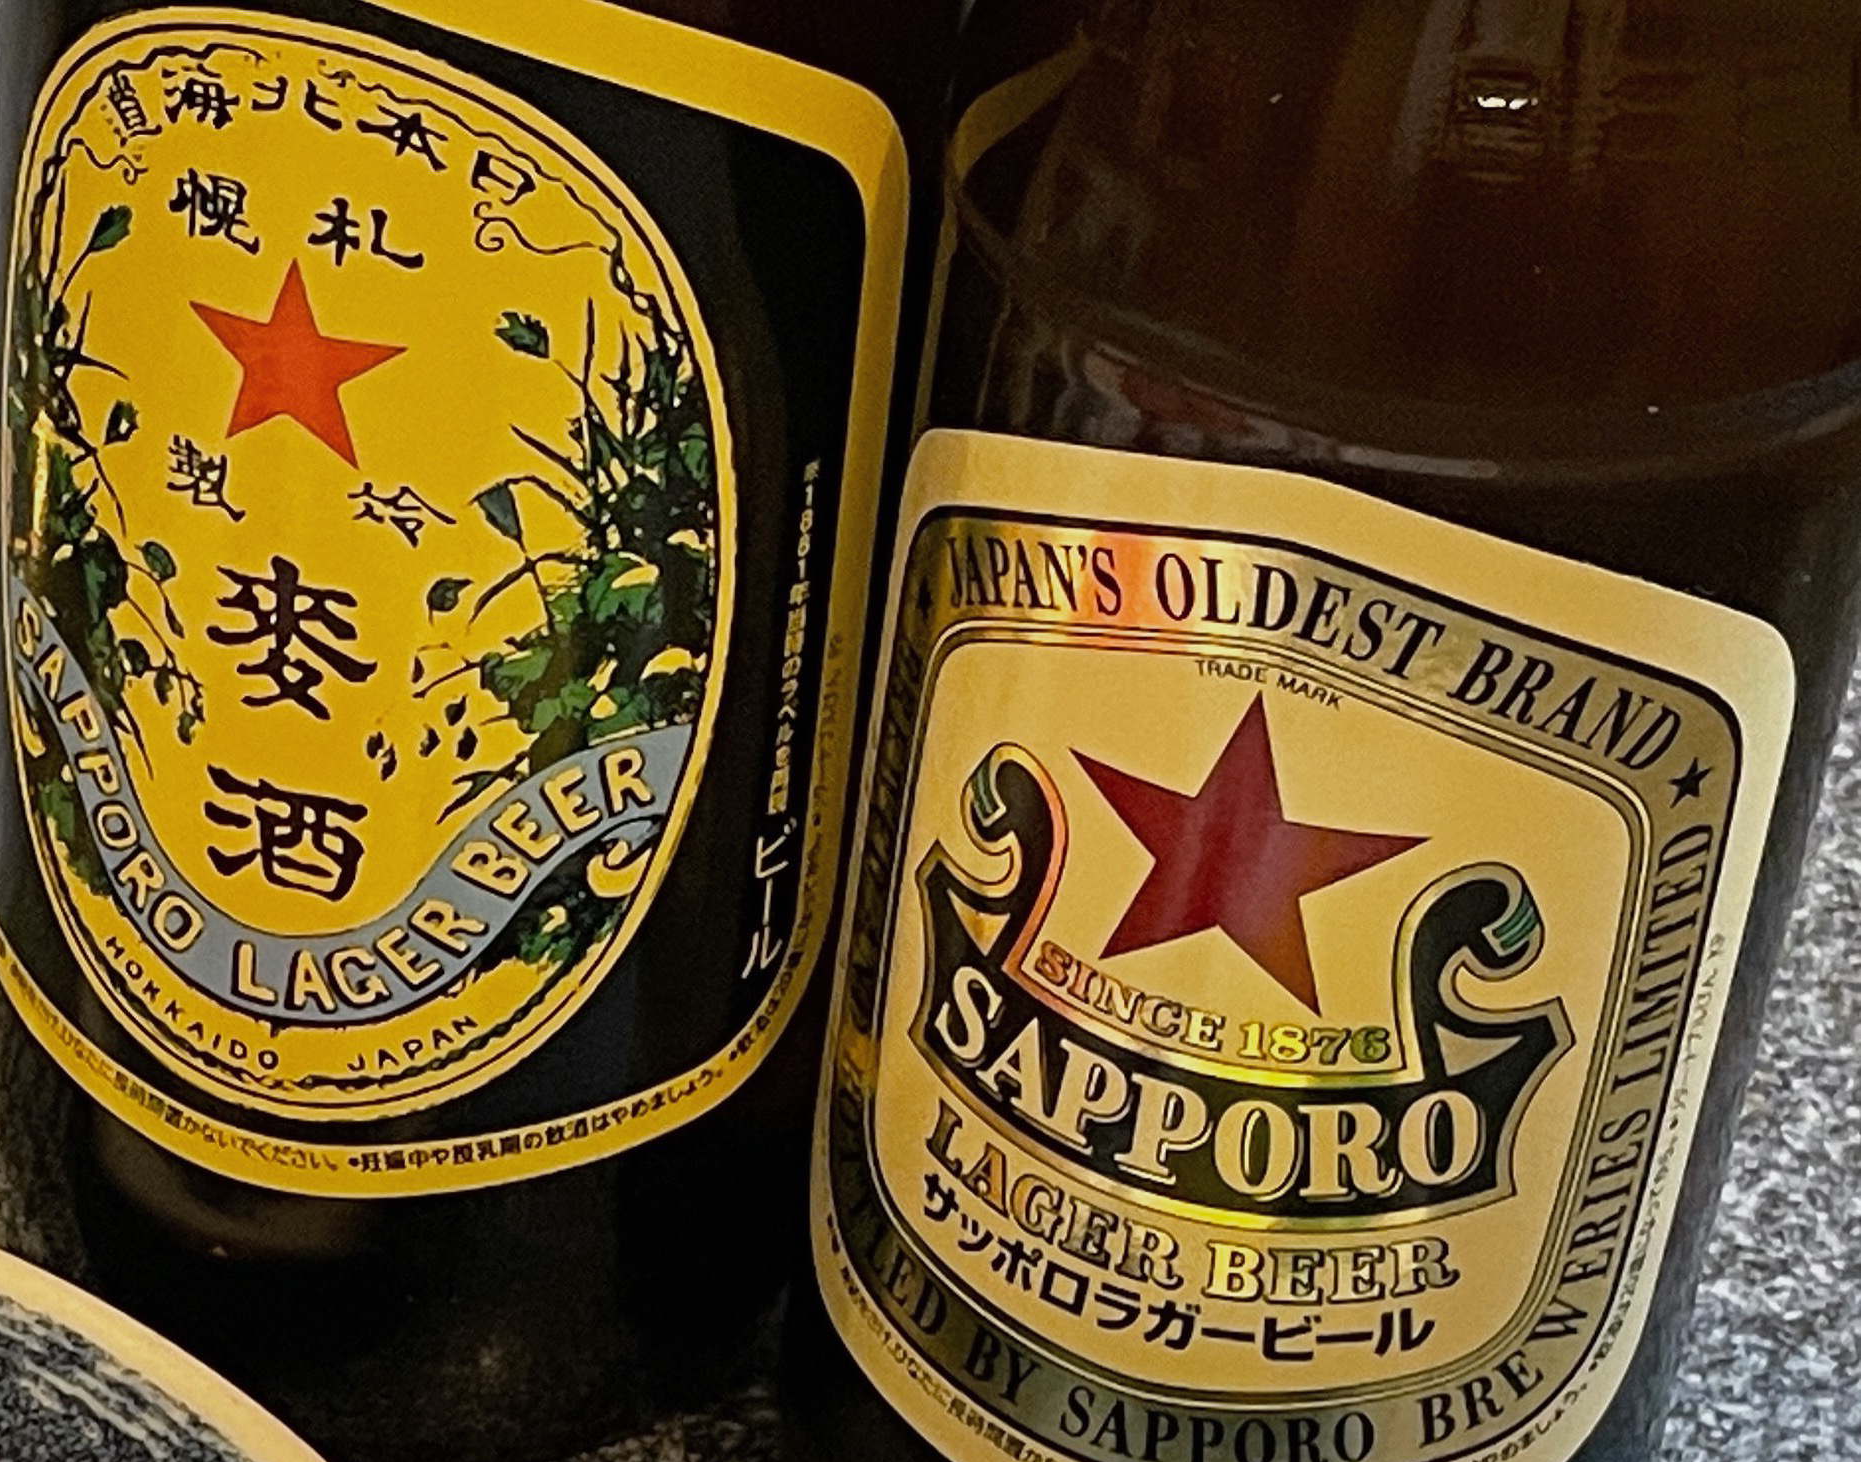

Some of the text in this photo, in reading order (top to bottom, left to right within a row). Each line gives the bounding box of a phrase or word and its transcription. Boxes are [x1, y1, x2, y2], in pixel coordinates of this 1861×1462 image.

[945, 535, 1684, 772] JAPAN'S OLDEST BRAND
[1194, 657, 1345, 711] TRADE MARK
[16, 596, 658, 1016] SAPPORO LAGER BEER
[105, 935, 479, 1072] HOKKAIDO JAPAN
[933, 966, 1485, 1203] SAPPORO
[1034, 939, 1394, 1064] SINCE 1876
[924, 1100, 1185, 1291] LAGER
[1204, 1237, 1458, 1307] BEER
[962, 1323, 1041, 1406] BY
[1417, 1107, 1652, 1449] BREWERIES
[1611, 822, 1716, 1095] LIMITED
[921, 1174, 1436, 1362] サッポロラガービール
